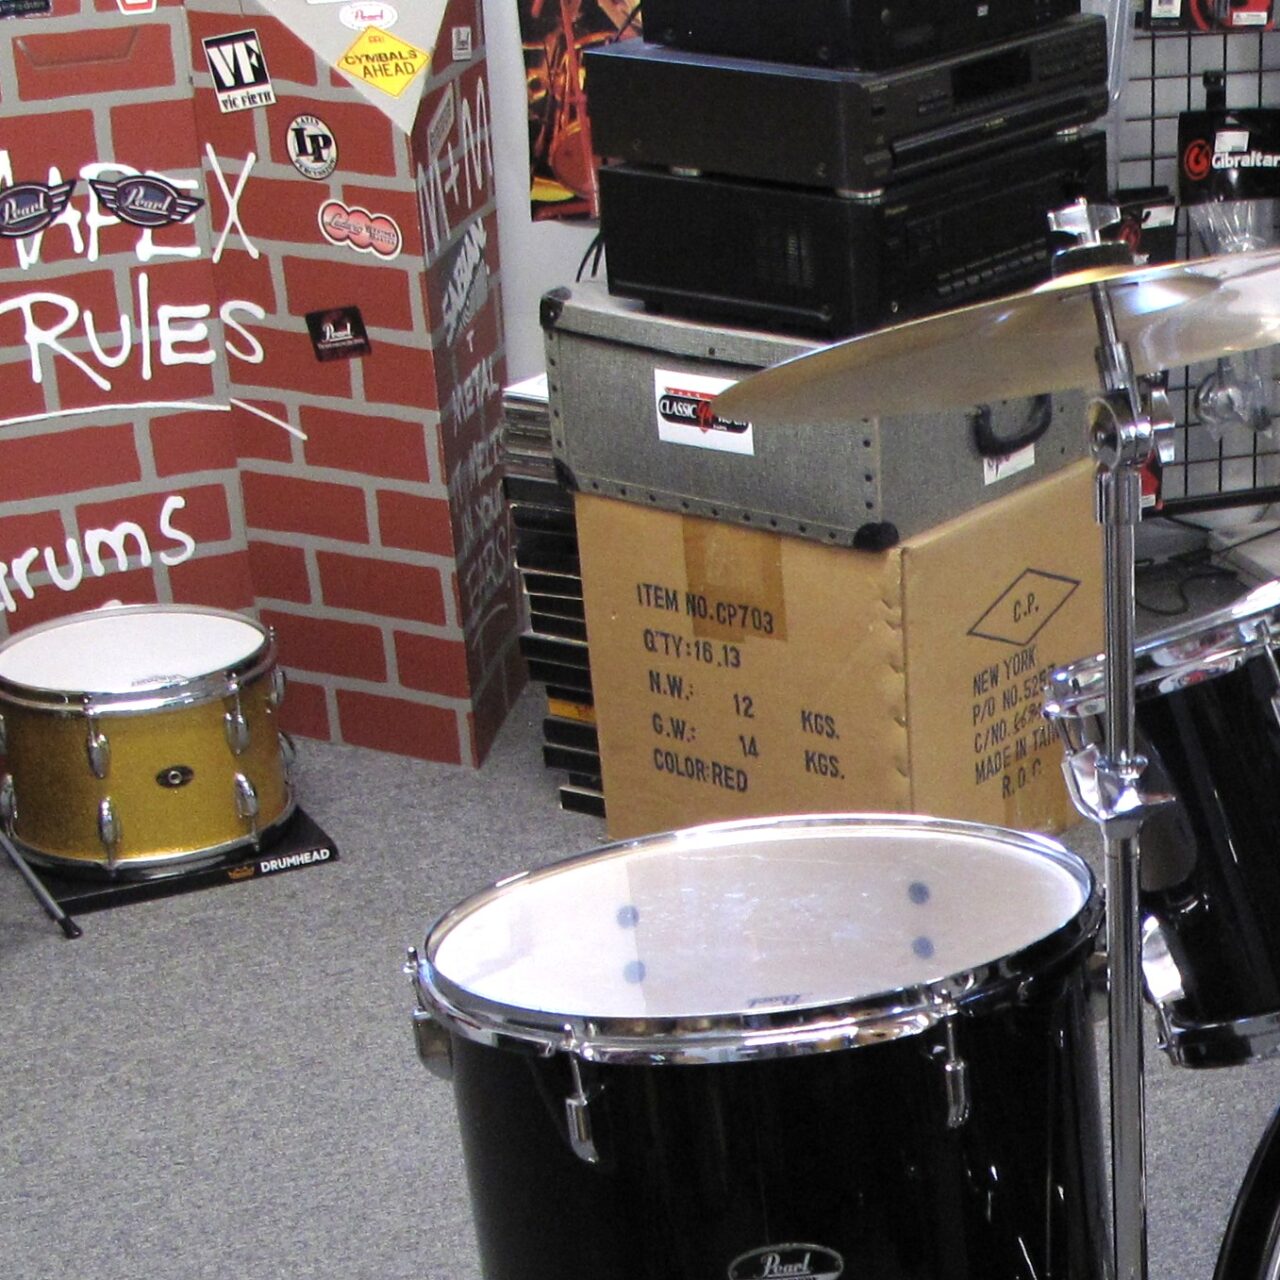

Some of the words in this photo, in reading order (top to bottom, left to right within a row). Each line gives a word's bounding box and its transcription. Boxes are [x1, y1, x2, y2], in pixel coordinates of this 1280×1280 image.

[207, 40, 260, 88] VF
[344, 49, 418, 66] CYMBALS
[362, 61, 416, 79] AHEAD
[291, 127, 333, 163] LP
[2, 192, 48, 226] Pearl
[123, 185, 173, 215] Pearl
[660, 399, 698, 419] CLASSIC
[636, 583, 679, 612] ITEM
[685, 592, 774, 634] NO.CP703
[1013, 592, 1039, 623] C.P.
[972, 663, 999, 697] NEW
[1003, 644, 1036, 680] YORK
[649, 669, 694, 701] N.W.:
[733, 693, 755, 719] 12
[801, 709, 840, 740] KGS.
[972, 695, 996, 727] P/O
[652, 712, 697, 744] G.W.:
[739, 734, 760, 759] 14
[804, 749, 846, 780] KGS.
[975, 745, 1012, 785] MADE
[1015, 736, 1027, 762] IN
[653, 747, 748, 793] COLOR:RED
[260, 848, 331, 874] DRUMHEAD
[752, 1252, 814, 1279] Pearl
